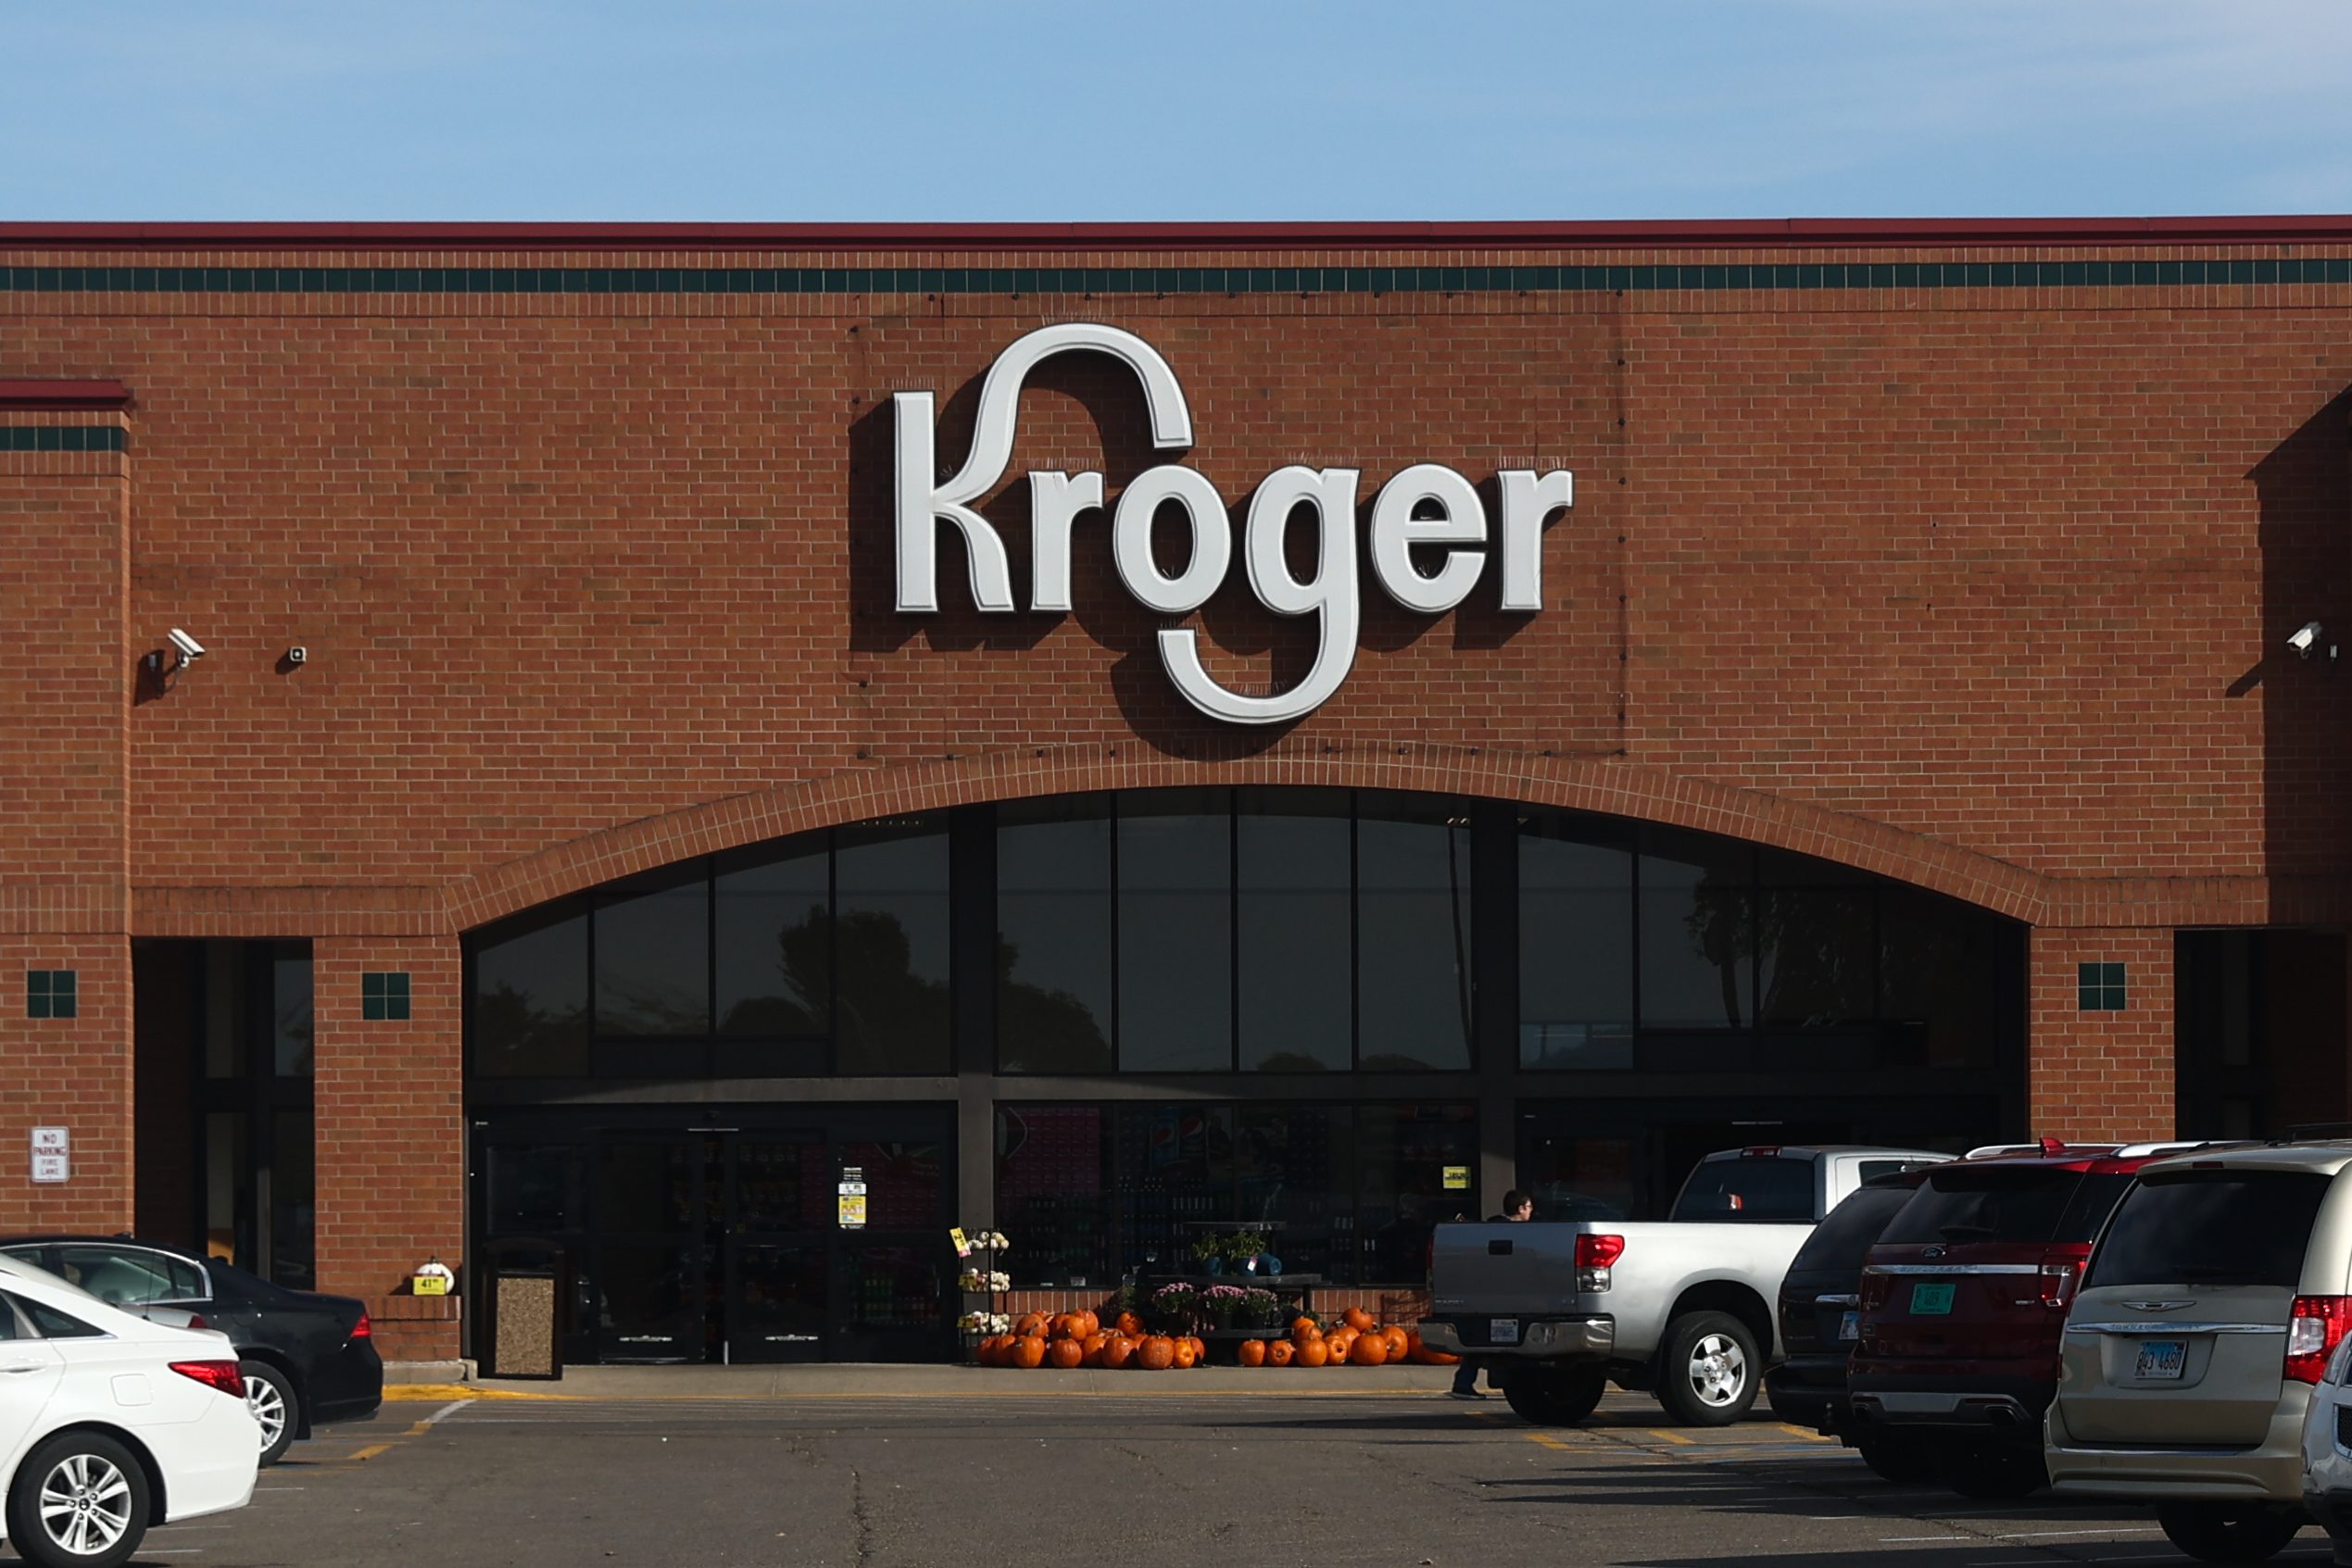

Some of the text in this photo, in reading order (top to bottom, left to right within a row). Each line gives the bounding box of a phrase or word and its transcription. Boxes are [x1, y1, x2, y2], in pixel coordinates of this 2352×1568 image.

[894, 322, 1573, 724] Kroger
[43, 1134, 57, 1144] NO
[33, 1147, 67, 1157] PARKING
[2136, 1351, 2182, 1370] 843 4680
